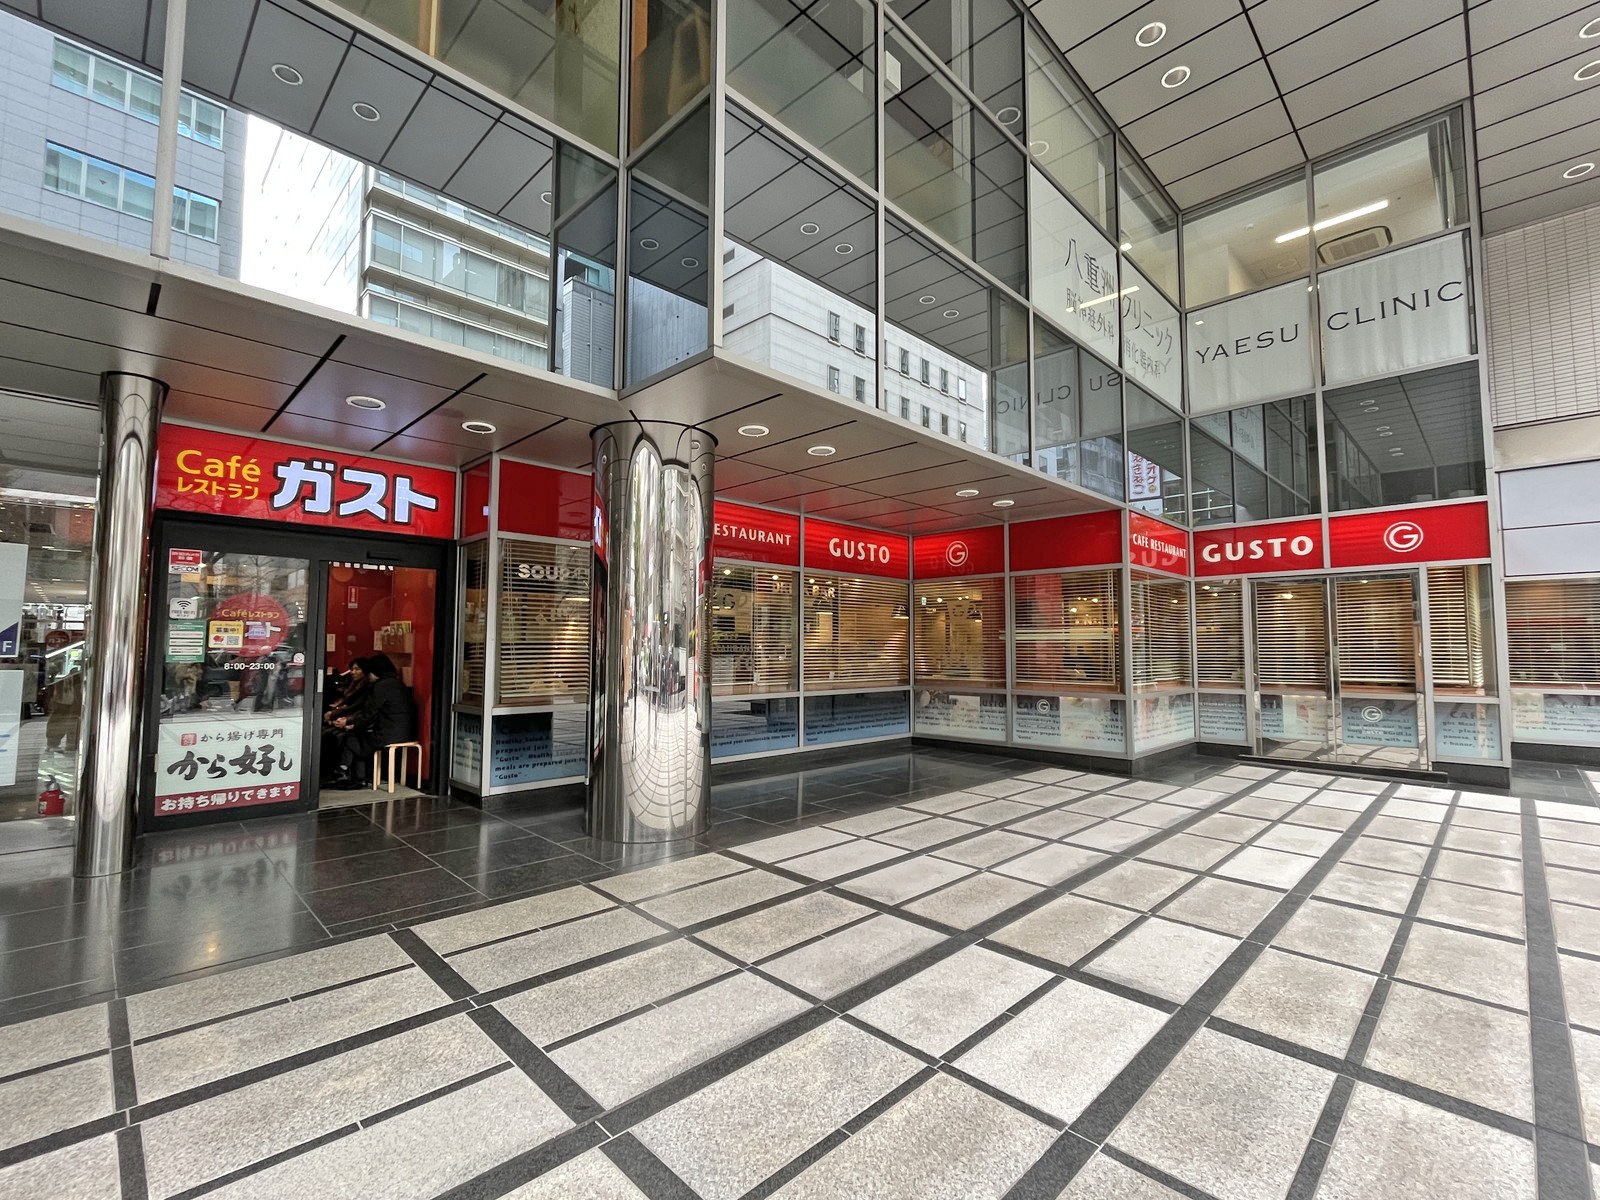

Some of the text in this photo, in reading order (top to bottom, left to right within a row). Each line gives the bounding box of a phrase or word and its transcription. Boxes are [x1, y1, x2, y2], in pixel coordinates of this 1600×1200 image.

[1195, 281, 1464, 364] YAESU CLINIC
[176, 449, 261, 482] Café
[177, 476, 258, 500] レストラン
[271, 458, 438, 524] ガスト
[714, 523, 792, 546] ESTAURANT
[1132, 531, 1149, 549] CAFÉ
[1150, 538, 1186, 559] RESTAURANT
[829, 537, 890, 564] GUSTO
[1202, 535, 1314, 563] GUSTO
[1450, 710, 1476, 720] CAF
[201, 728, 283, 742] から揚げ専門
[166, 744, 293, 781] から好し
[161, 785, 294, 811] お持ち帰りできます
